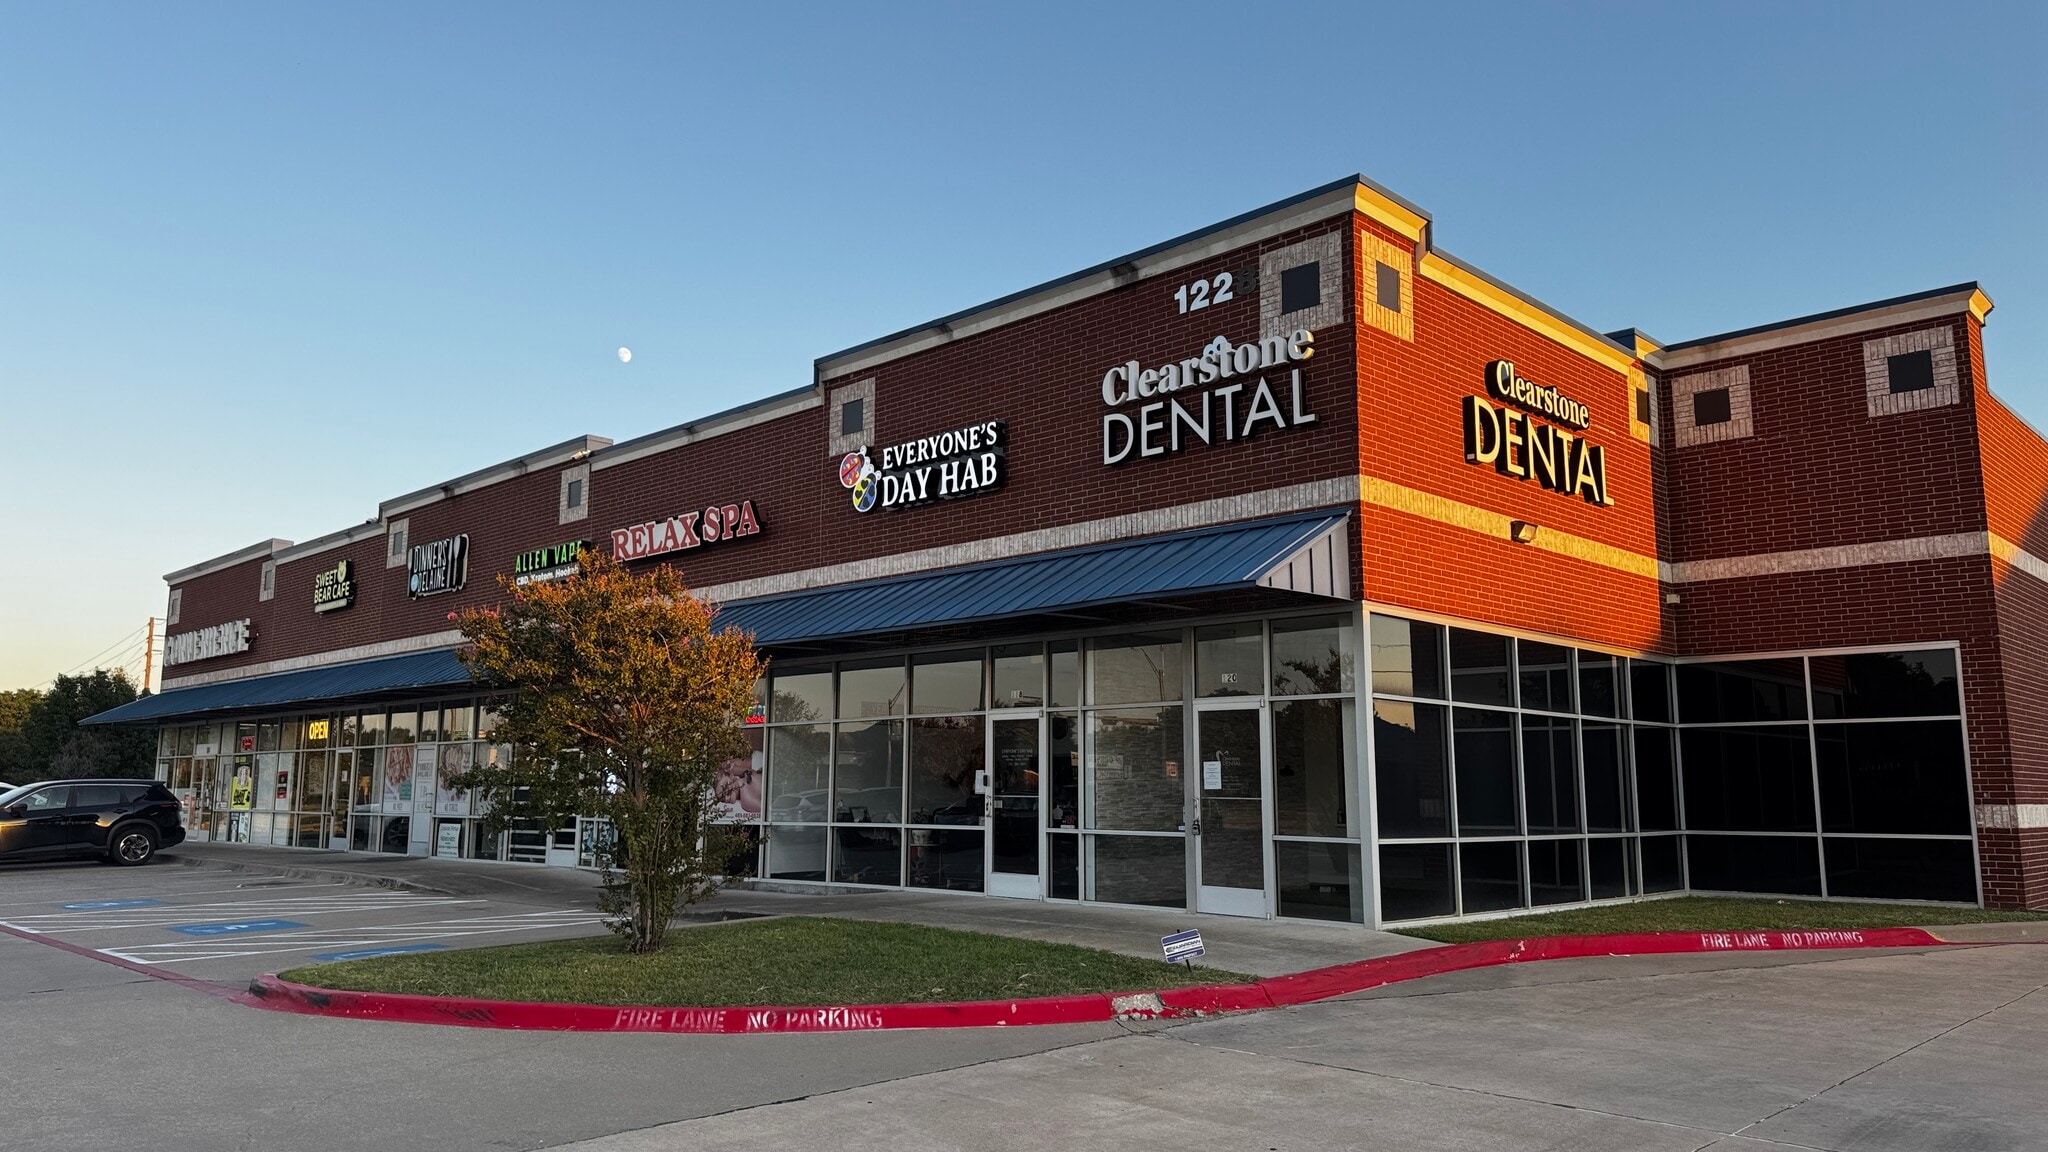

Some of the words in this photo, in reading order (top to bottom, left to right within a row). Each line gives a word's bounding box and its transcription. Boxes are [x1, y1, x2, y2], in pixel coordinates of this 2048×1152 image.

[1102, 328, 1315, 407] Clearstone
[1103, 368, 1317, 465] DENTAL
[1495, 360, 1590, 429] Clearstone
[882, 421, 998, 470] EVERYONE'S
[1473, 395, 1615, 507] DENTAL
[881, 467, 932, 507] DAY
[939, 452, 998, 495] HAB
[611, 510, 700, 562] RELAX
[702, 500, 760, 542] SPA
[315, 569, 338, 589] SWEET
[515, 548, 548, 573] ALLEN
[314, 585, 332, 604] BEAR
[332, 581, 350, 599] CAFE
[309, 721, 329, 740] OPEN
[1701, 933, 1733, 948] FIRE
[1736, 933, 1769, 947] LANE
[1780, 932, 1803, 947] NO
[1806, 931, 1864, 946] PARKING
[614, 1008, 664, 1029] FIRE
[670, 1009, 727, 1030] LANE
[746, 1009, 779, 1029] NO
[785, 1006, 884, 1029] PARKING
